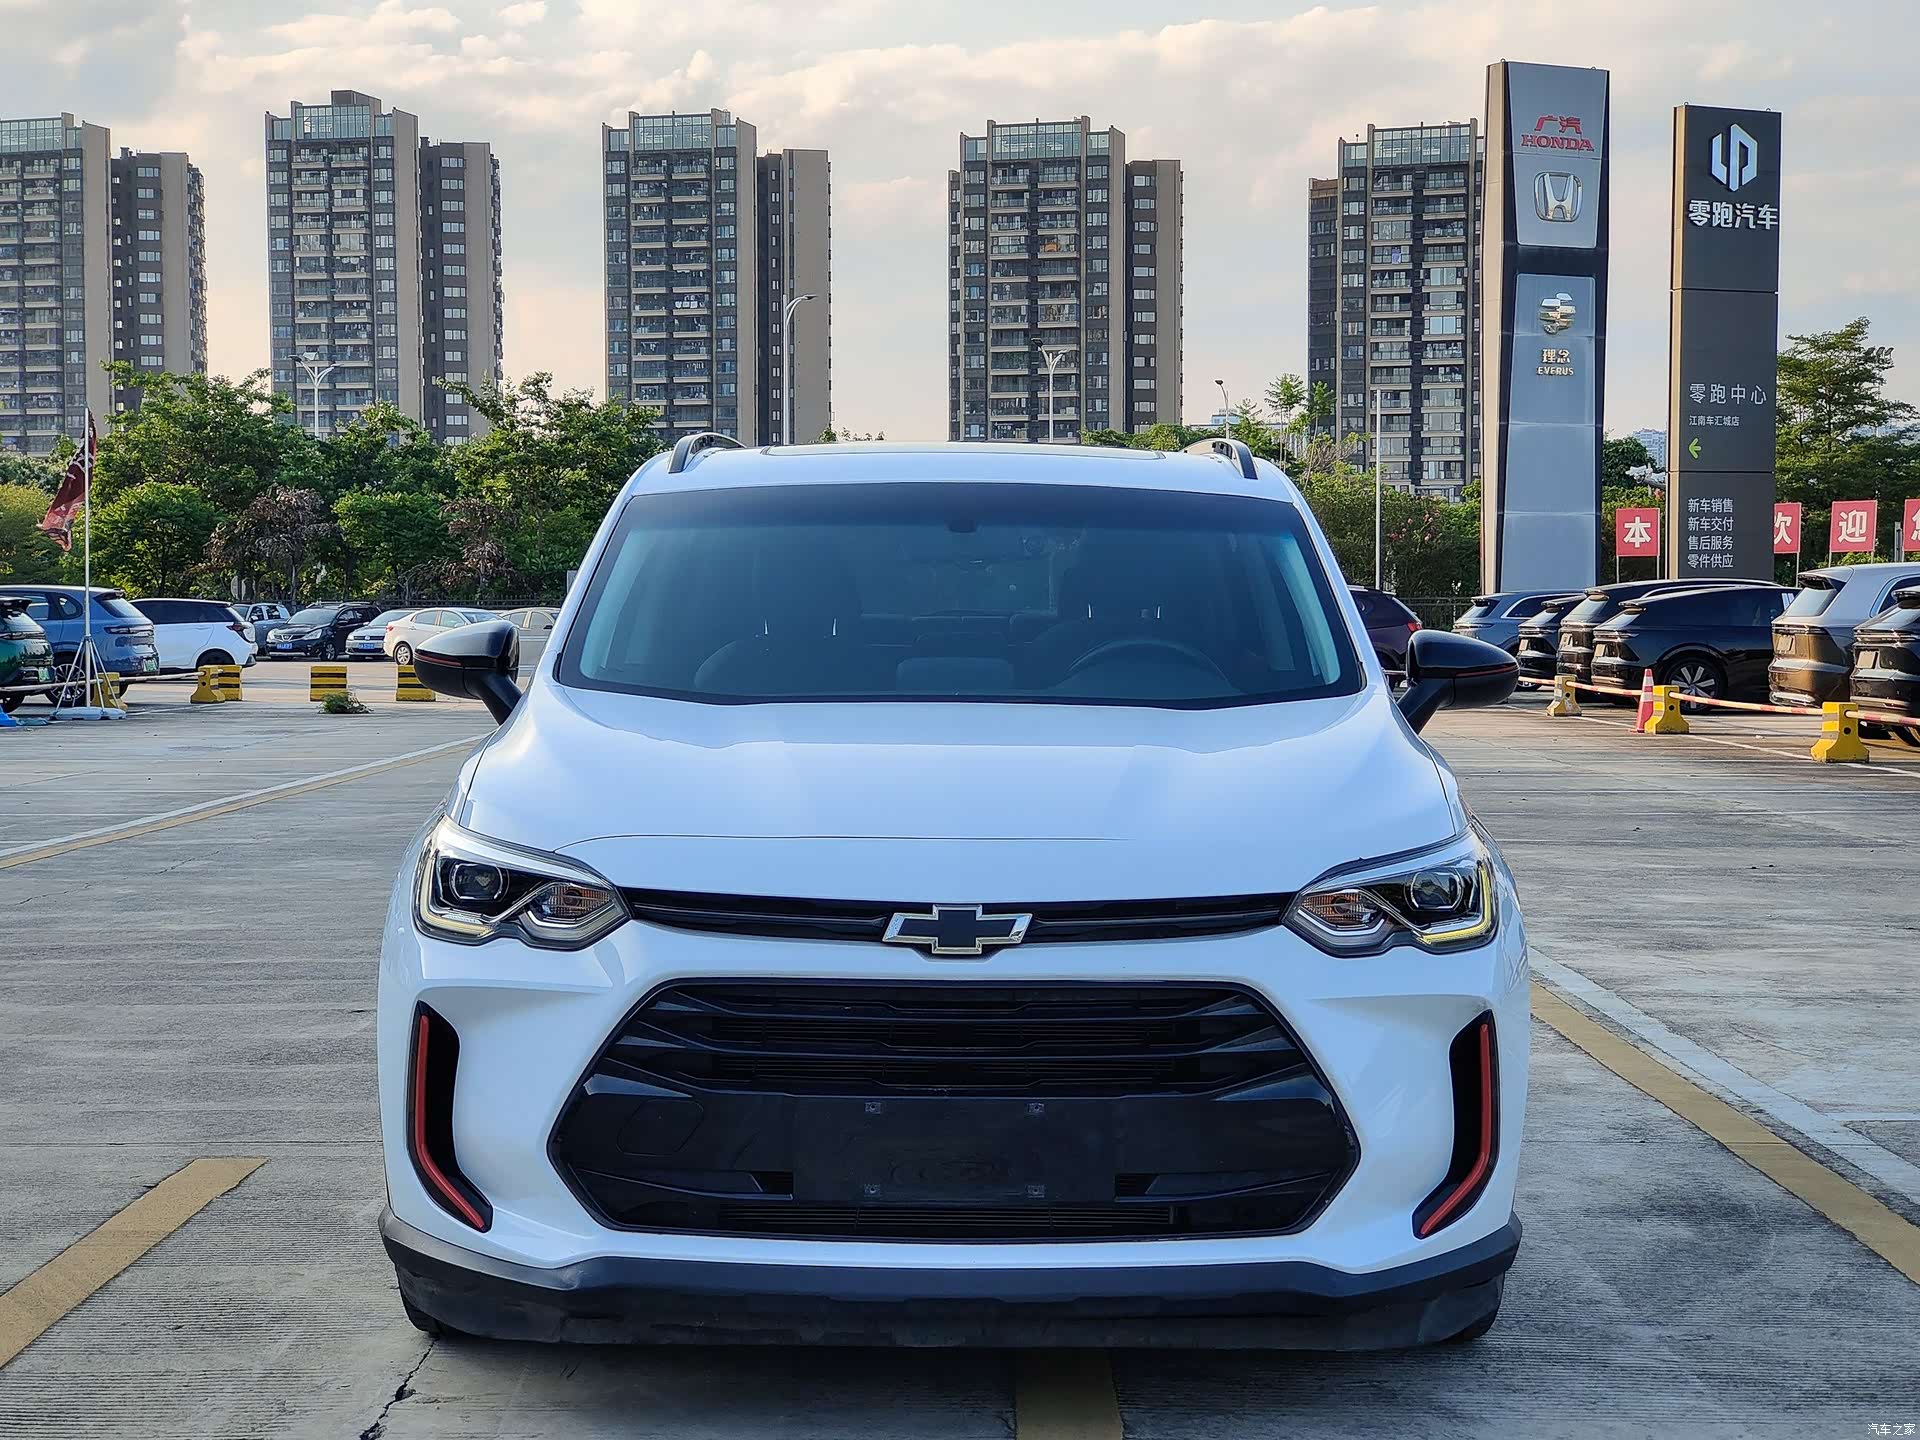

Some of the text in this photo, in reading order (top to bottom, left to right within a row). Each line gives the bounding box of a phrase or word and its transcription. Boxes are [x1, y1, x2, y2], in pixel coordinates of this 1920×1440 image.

[1534, 114, 1582, 134] 广汽
[1521, 134, 1594, 152] HONDA
[1688, 199, 1779, 230] 零跑汽车
[1541, 348, 1571, 364] 理念
[1537, 366, 1574, 376] EVERUS
[1689, 383, 1767, 405] 零跑中心
[1688, 415, 1740, 426] 江南车汇城店
[1687, 497, 1734, 513] 新车销售
[1623, 516, 1652, 548] 本
[1837, 509, 1868, 543] 迎
[1687, 516, 1734, 531] 新车交付
[1687, 535, 1734, 551] 售后服务
[1687, 553, 1734, 569] 零件供应
